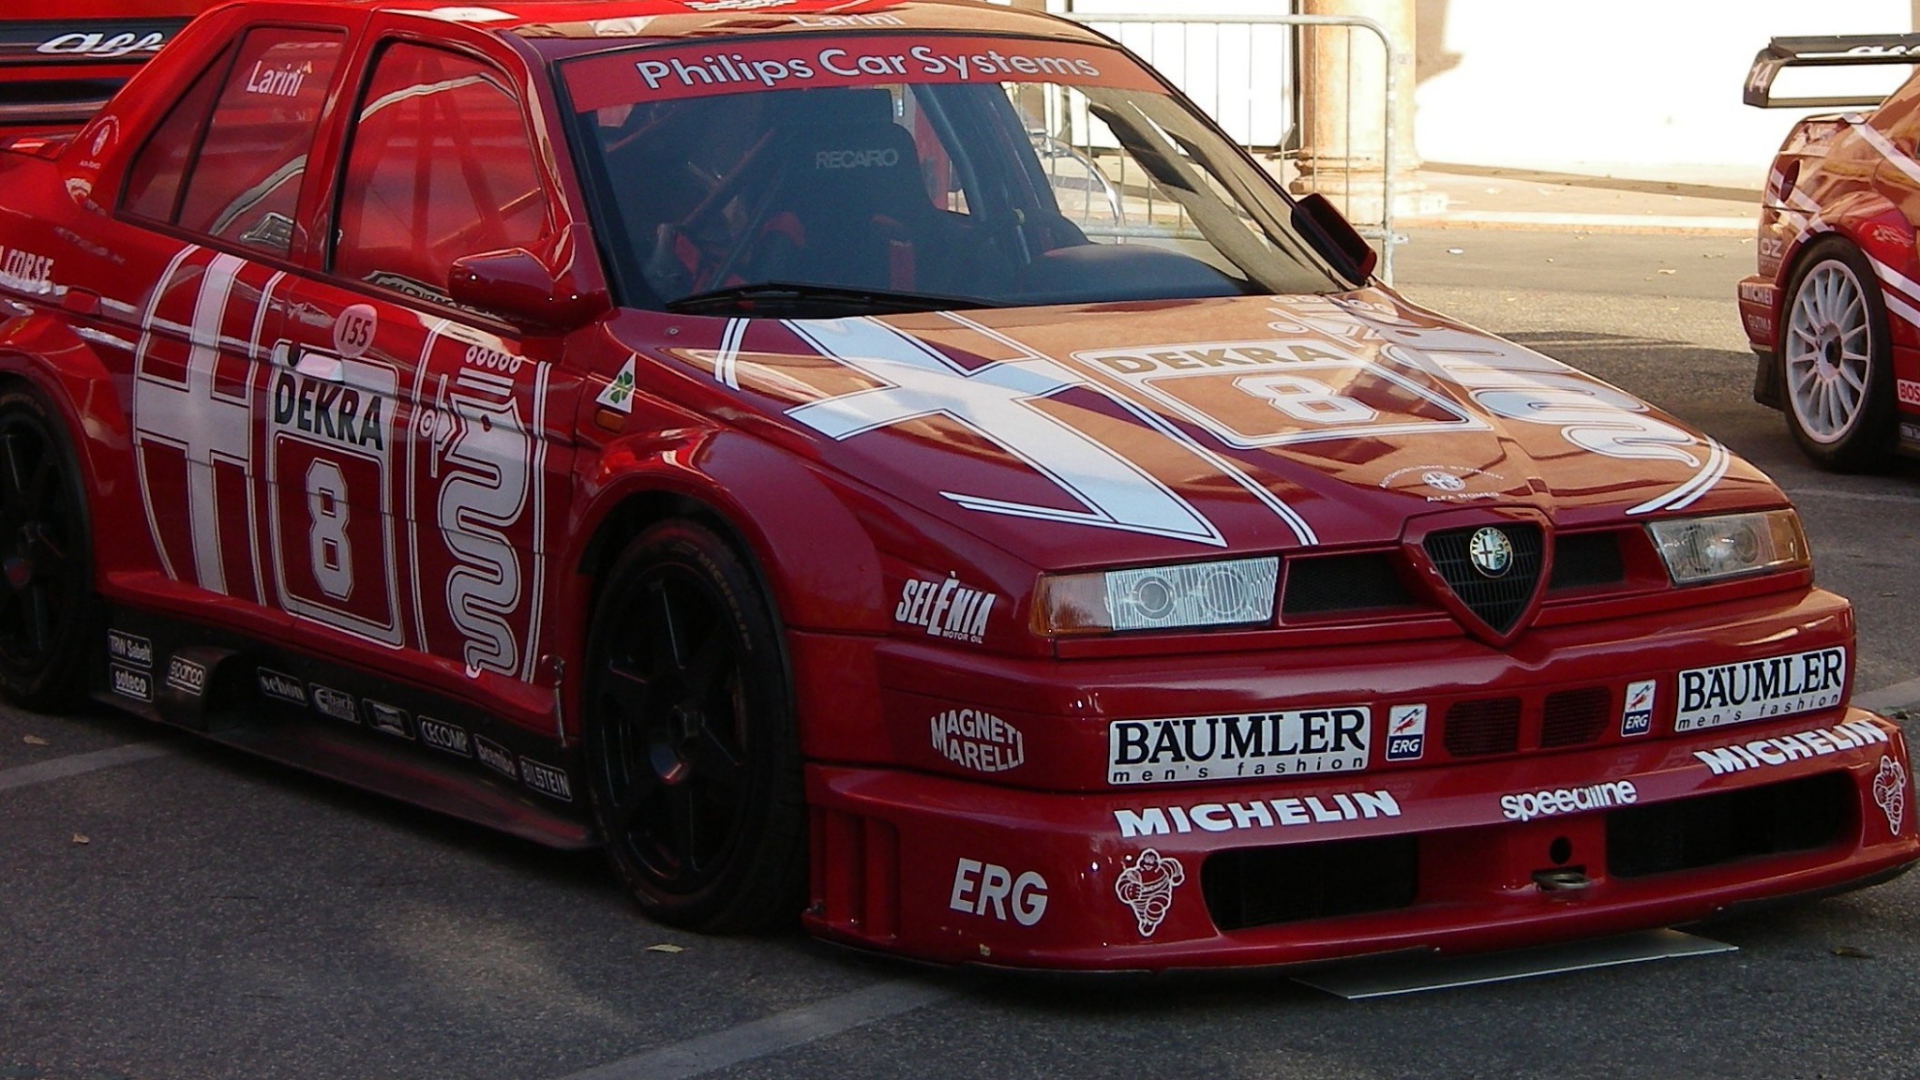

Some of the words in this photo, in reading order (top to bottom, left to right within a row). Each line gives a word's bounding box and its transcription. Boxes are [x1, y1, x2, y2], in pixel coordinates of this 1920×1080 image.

[36, 33, 165, 57] alf
[246, 60, 305, 97] Larini
[636, 54, 815, 89] Philips
[818, 49, 907, 77] Car
[910, 46, 1100, 80] Systems
[1748, 62, 1774, 93] 14
[815, 148, 898, 169] RECARO
[5, 248, 54, 282] CORSE
[1760, 238, 1782, 258] OZ
[340, 314, 372, 347] 155
[1095, 344, 1348, 375] DEKRA
[274, 371, 384, 452] DEKRA
[1231, 374, 1380, 424] 8
[305, 456, 354, 602] 8
[942, 630, 969, 641] MOTOR
[970, 635, 984, 645] OIL
[1680, 649, 1842, 713] BÄUMLER
[1624, 713, 1650, 730] ERG
[1678, 708, 1742, 731] men's
[1759, 693, 1839, 717] fashion
[931, 708, 1024, 754] MAGNETI
[1113, 709, 1367, 766] BÄUMLER
[1390, 737, 1421, 754] ERG
[1693, 719, 1889, 776] MICHELIN
[931, 728, 1024, 772] MARELLI
[520, 760, 571, 797] BILSTEIN
[1112, 764, 1209, 783] men's
[1237, 755, 1364, 777] fashion
[1113, 789, 1402, 838] MICHELIN
[950, 857, 1048, 927] ERG
